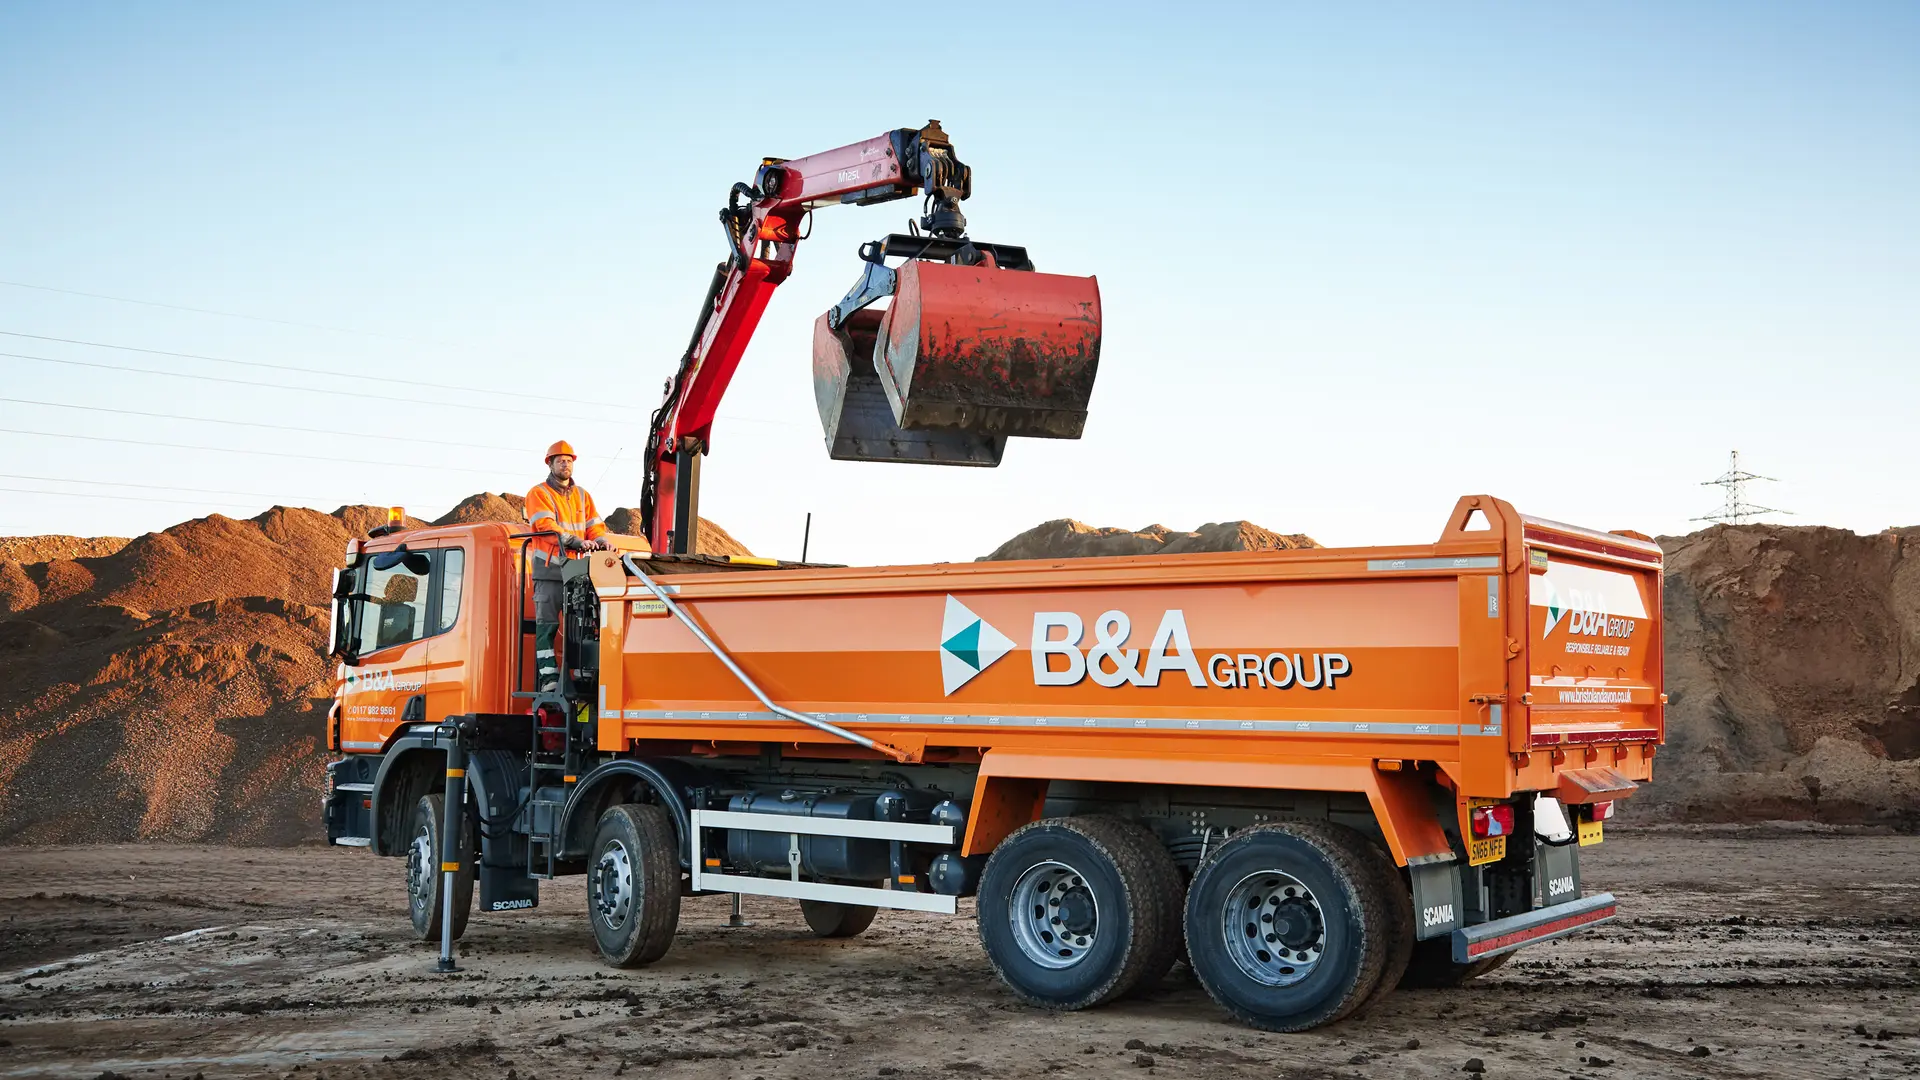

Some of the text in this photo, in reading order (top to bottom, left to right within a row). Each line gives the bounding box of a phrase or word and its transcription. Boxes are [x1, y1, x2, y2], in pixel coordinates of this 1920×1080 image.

[1569, 588, 1634, 640] B&A GROUP
[1031, 609, 1352, 691] B&A GROUP
[363, 670, 422, 692] B&A GROUP
[352, 705, 367, 715] 0117
[380, 706, 396, 716] 9561
[791, 852, 798, 861] T
[1472, 841, 1488, 861] SN66
[1548, 876, 1575, 897] SCANIA
[492, 899, 533, 911] SCANIA
[1423, 904, 1455, 927] SCANIA
